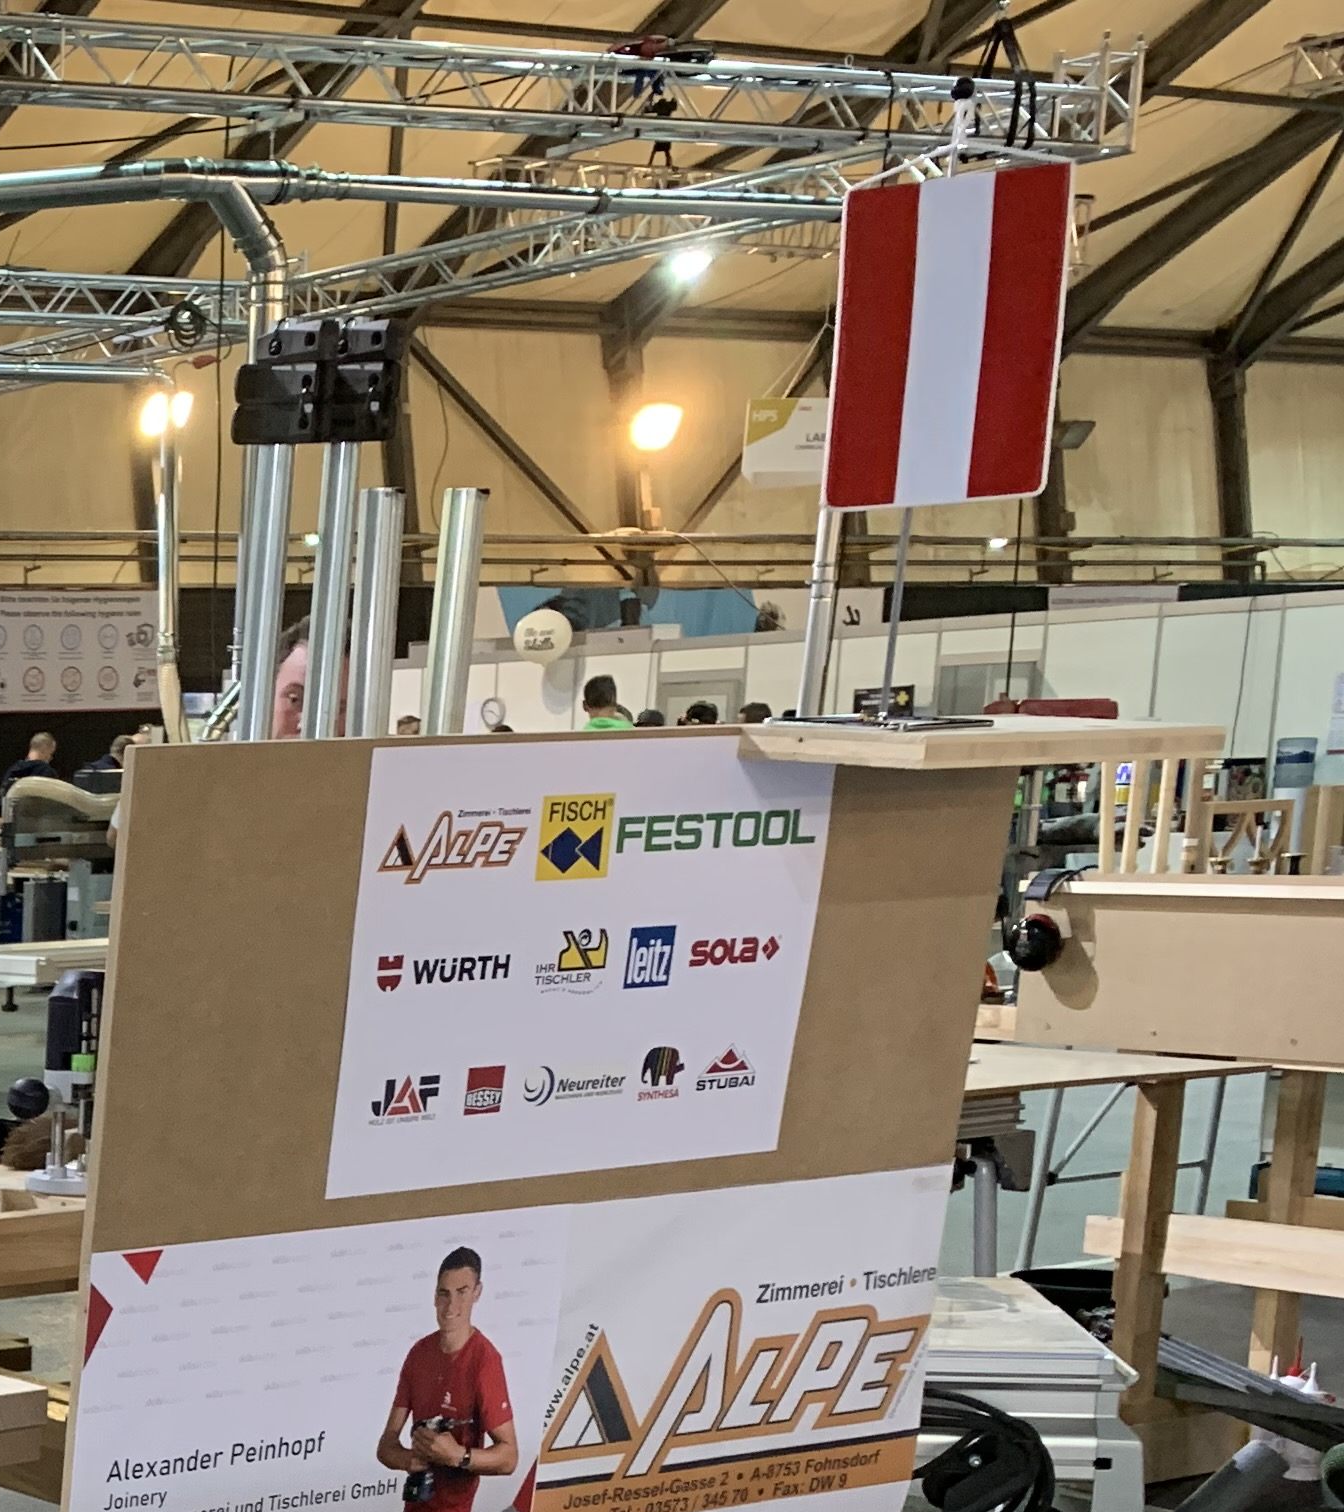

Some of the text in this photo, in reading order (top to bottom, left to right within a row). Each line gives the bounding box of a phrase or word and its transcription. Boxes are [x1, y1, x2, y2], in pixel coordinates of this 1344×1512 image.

[548, 800, 607, 823] FISCH
[615, 808, 816, 854] FESTOOL
[404, 810, 528, 885] ALPE
[413, 954, 511, 985] WÜRTH
[535, 963, 556, 974] IHR
[626, 937, 672, 985] leitz
[535, 972, 592, 986] TISCHLER
[370, 1074, 441, 1117] JAF
[556, 1074, 626, 1093] Neureiter
[636, 1088, 680, 1101] SYNTHESA
[696, 1075, 756, 1092] STUBAI
[756, 1274, 844, 1304] Zimmerei
[621, 1287, 932, 1479] ALPE
[106, 1431, 326, 1483] Alexander Peinhopf
[268, 1485, 346, 1512] Tischlerei
[350, 1477, 398, 1500] GmbH
[563, 1448, 880, 1511] Josef-Ressel-Gasse 2 A-8753 Fohnsdorf
[772, 1481, 805, 1498] Fax:
[809, 1476, 835, 1493] DW
[838, 1473, 848, 1488] 9
[103, 1489, 168, 1511] Joinery
